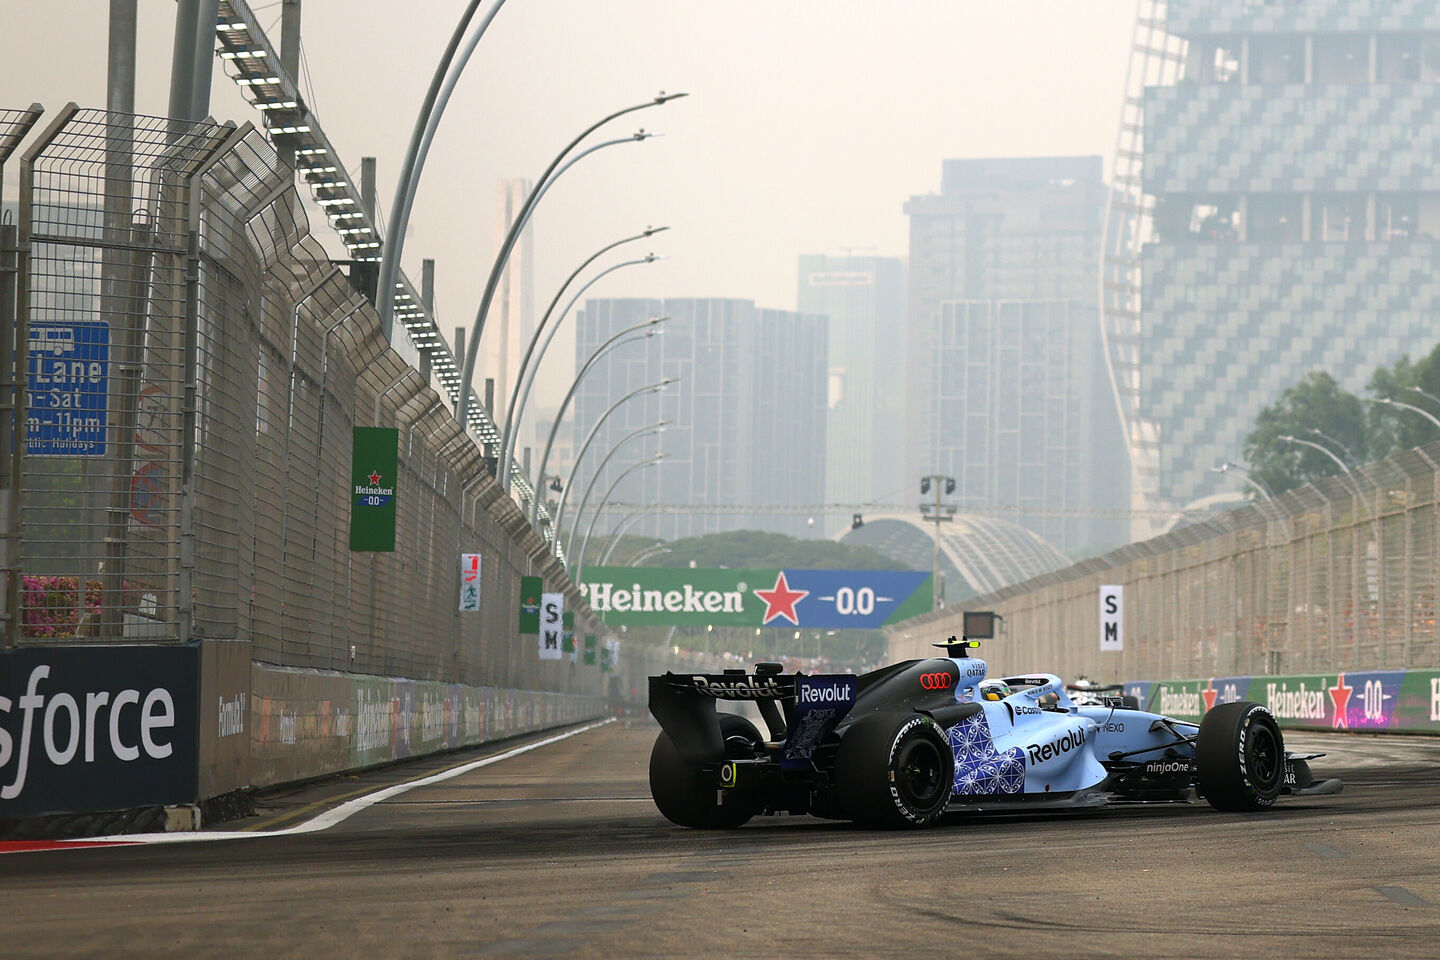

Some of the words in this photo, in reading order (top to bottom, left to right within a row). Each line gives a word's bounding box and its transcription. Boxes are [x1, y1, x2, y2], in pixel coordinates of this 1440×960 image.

[36, 354, 101, 383] Lane
[52, 438, 94, 451] Holidays
[355, 485, 392, 496] Heineken
[590, 583, 744, 613] Heineken
[836, 587, 876, 615] 0.0
[967, 668, 986, 678] QATAR
[693, 676, 784, 698] Revolut
[801, 683, 851, 703] Revolut
[1160, 686, 1201, 716] Heineken
[1267, 683, 1326, 719] Heineken
[1102, 723, 1125, 733] NEXO
[1026, 725, 1086, 766] Revolut
[1239, 729, 1248, 775] ZERO
[1146, 761, 1189, 775] ninjaOne
[889, 786, 917, 821] ZERO
